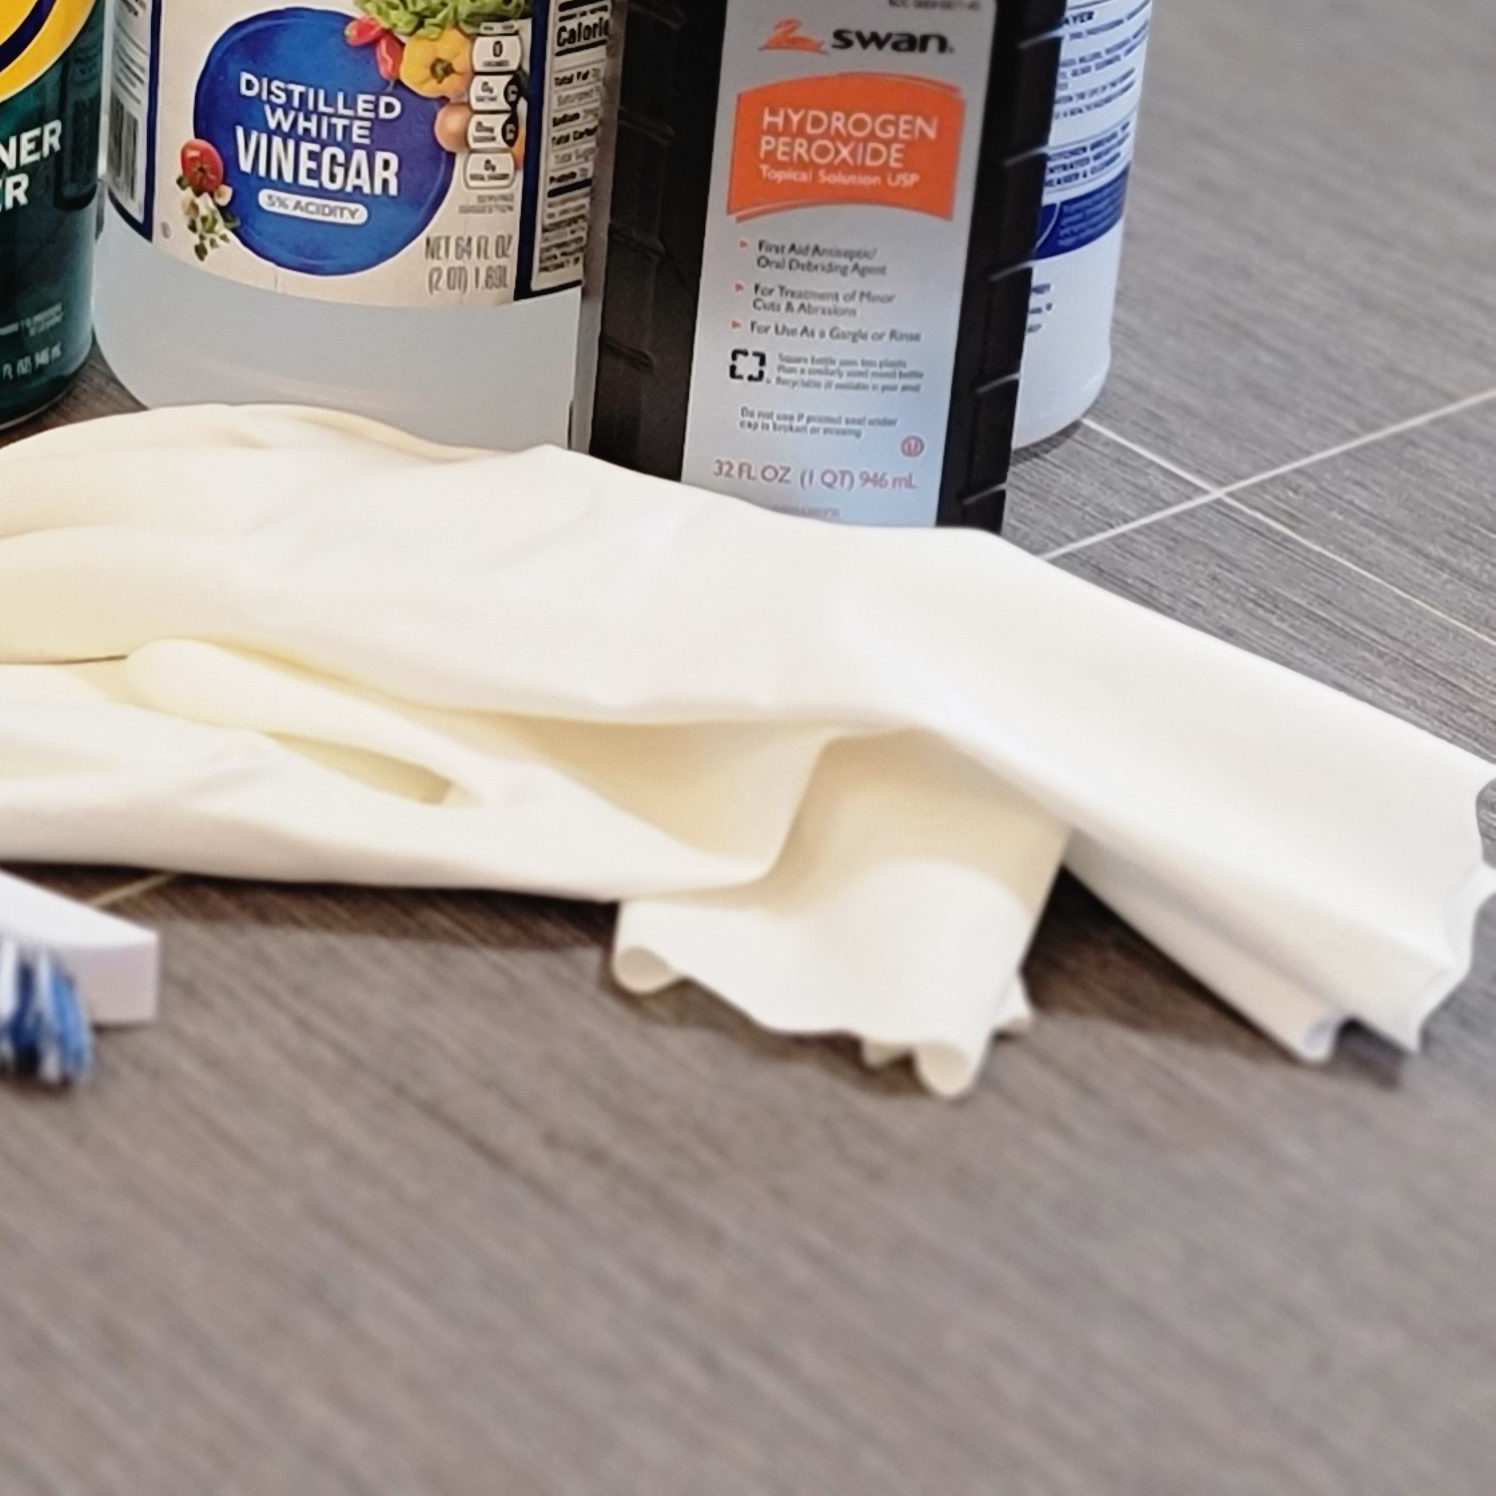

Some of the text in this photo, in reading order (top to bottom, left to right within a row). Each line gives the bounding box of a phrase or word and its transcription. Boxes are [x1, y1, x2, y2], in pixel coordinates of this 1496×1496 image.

[492, 40, 504, 58] 0
[831, 28, 948, 53] swan
[239, 71, 402, 120] DISTILLED
[264, 104, 372, 144] WHITE
[763, 106, 938, 140] HYDROGEN
[235, 125, 400, 197] VINEGAR
[759, 135, 907, 169] PEROXIDE
[759, 164, 920, 188] Topical Solution USP
[266, 193, 360, 220] 5% ACIDITY
[425, 235, 452, 261] NET
[454, 235, 473, 261] 64
[495, 234, 513, 260] OZ
[758, 239, 786, 255] First
[788, 241, 810, 256] Aid
[756, 255, 887, 278] Oral Debriding Agent
[754, 283, 896, 304] For Treatment of Minor
[753, 298, 781, 312] Cuts
[797, 302, 857, 317] Abrasions
[751, 320, 771, 335] For
[774, 322, 798, 337] Use
[800, 325, 816, 339] As
[829, 326, 868, 344] Gargle
[871, 330, 886, 341] or
[889, 329, 921, 343] Rinse
[713, 459, 734, 478] 32
[760, 465, 792, 484] OZ
[820, 469, 855, 491] QT)
[859, 471, 890, 489] 946
[892, 474, 917, 490] mL
